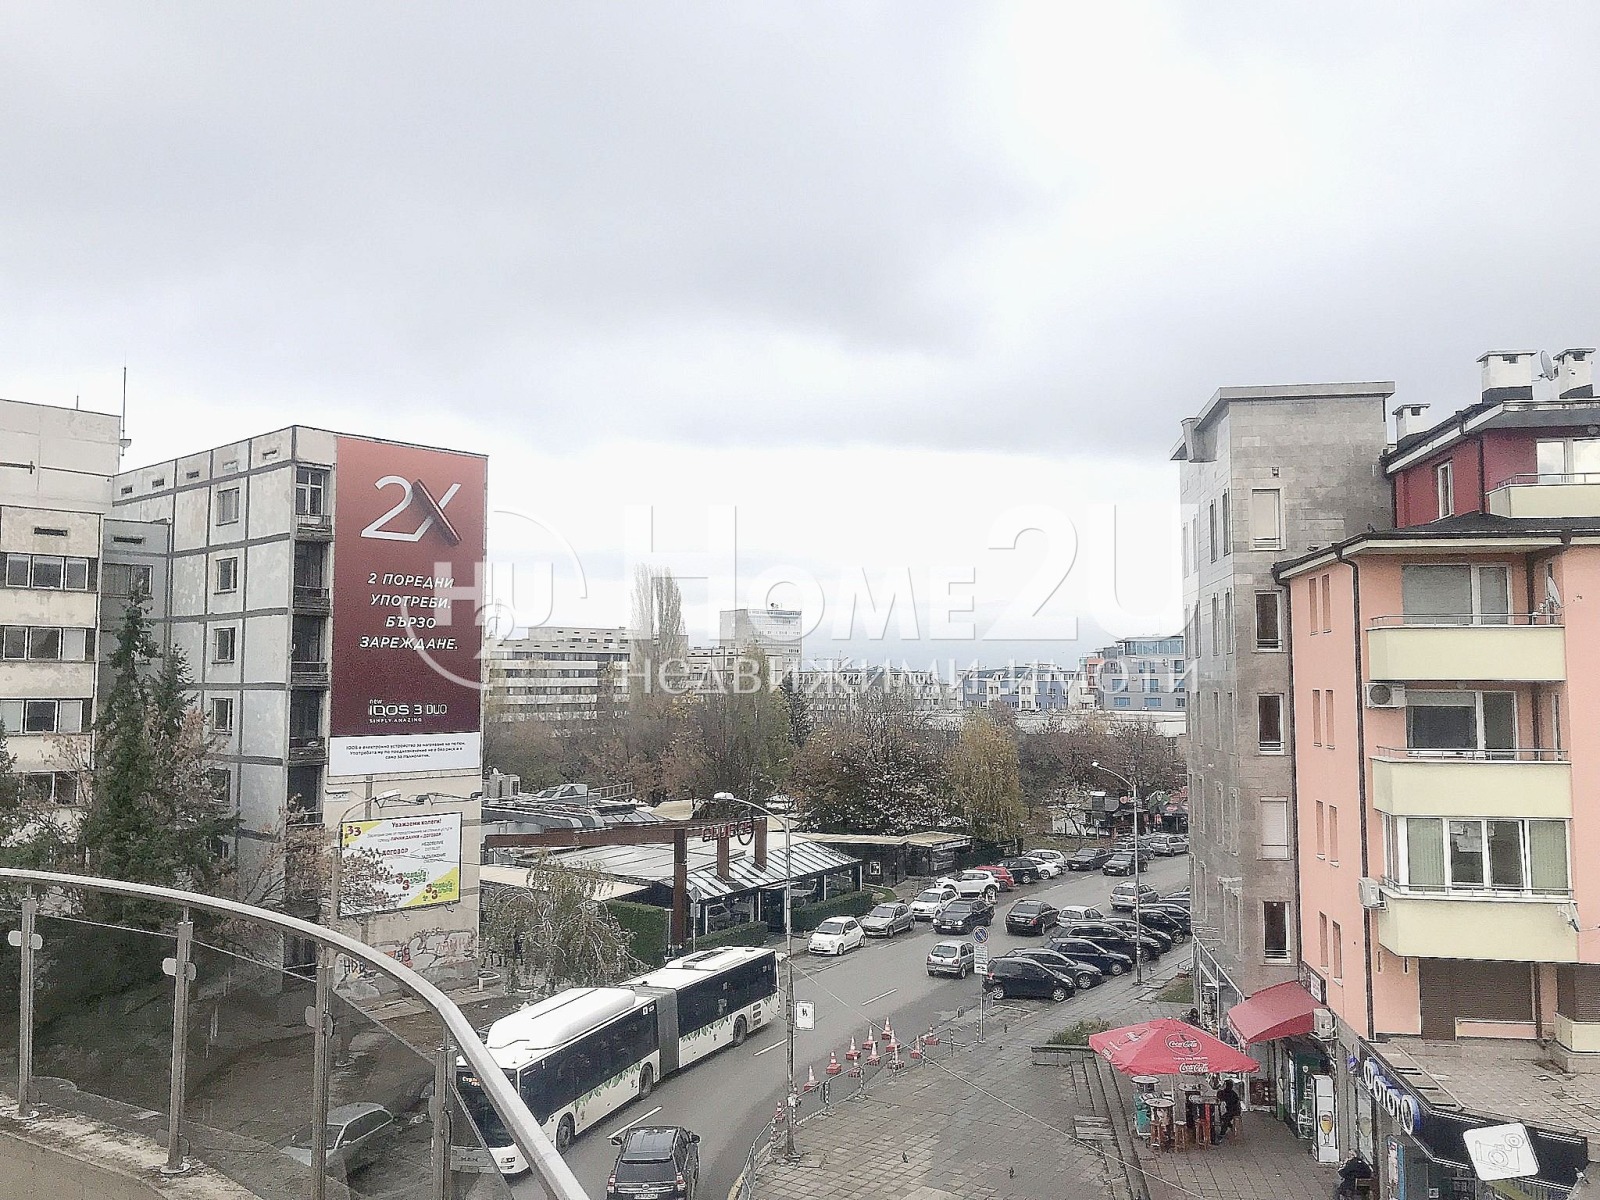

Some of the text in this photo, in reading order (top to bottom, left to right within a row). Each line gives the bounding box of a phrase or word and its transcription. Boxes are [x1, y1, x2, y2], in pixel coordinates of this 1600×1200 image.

[368, 573, 455, 590] 2 ПОРЕДНИ
[371, 594, 451, 609] УПОТРЕБИ.
[386, 616, 436, 629] БЪРЗО
[360, 637, 458, 650] ЗАРЕЖДАНЕ.
[413, 704, 423, 715] 3
[426, 704, 448, 715] DUO
